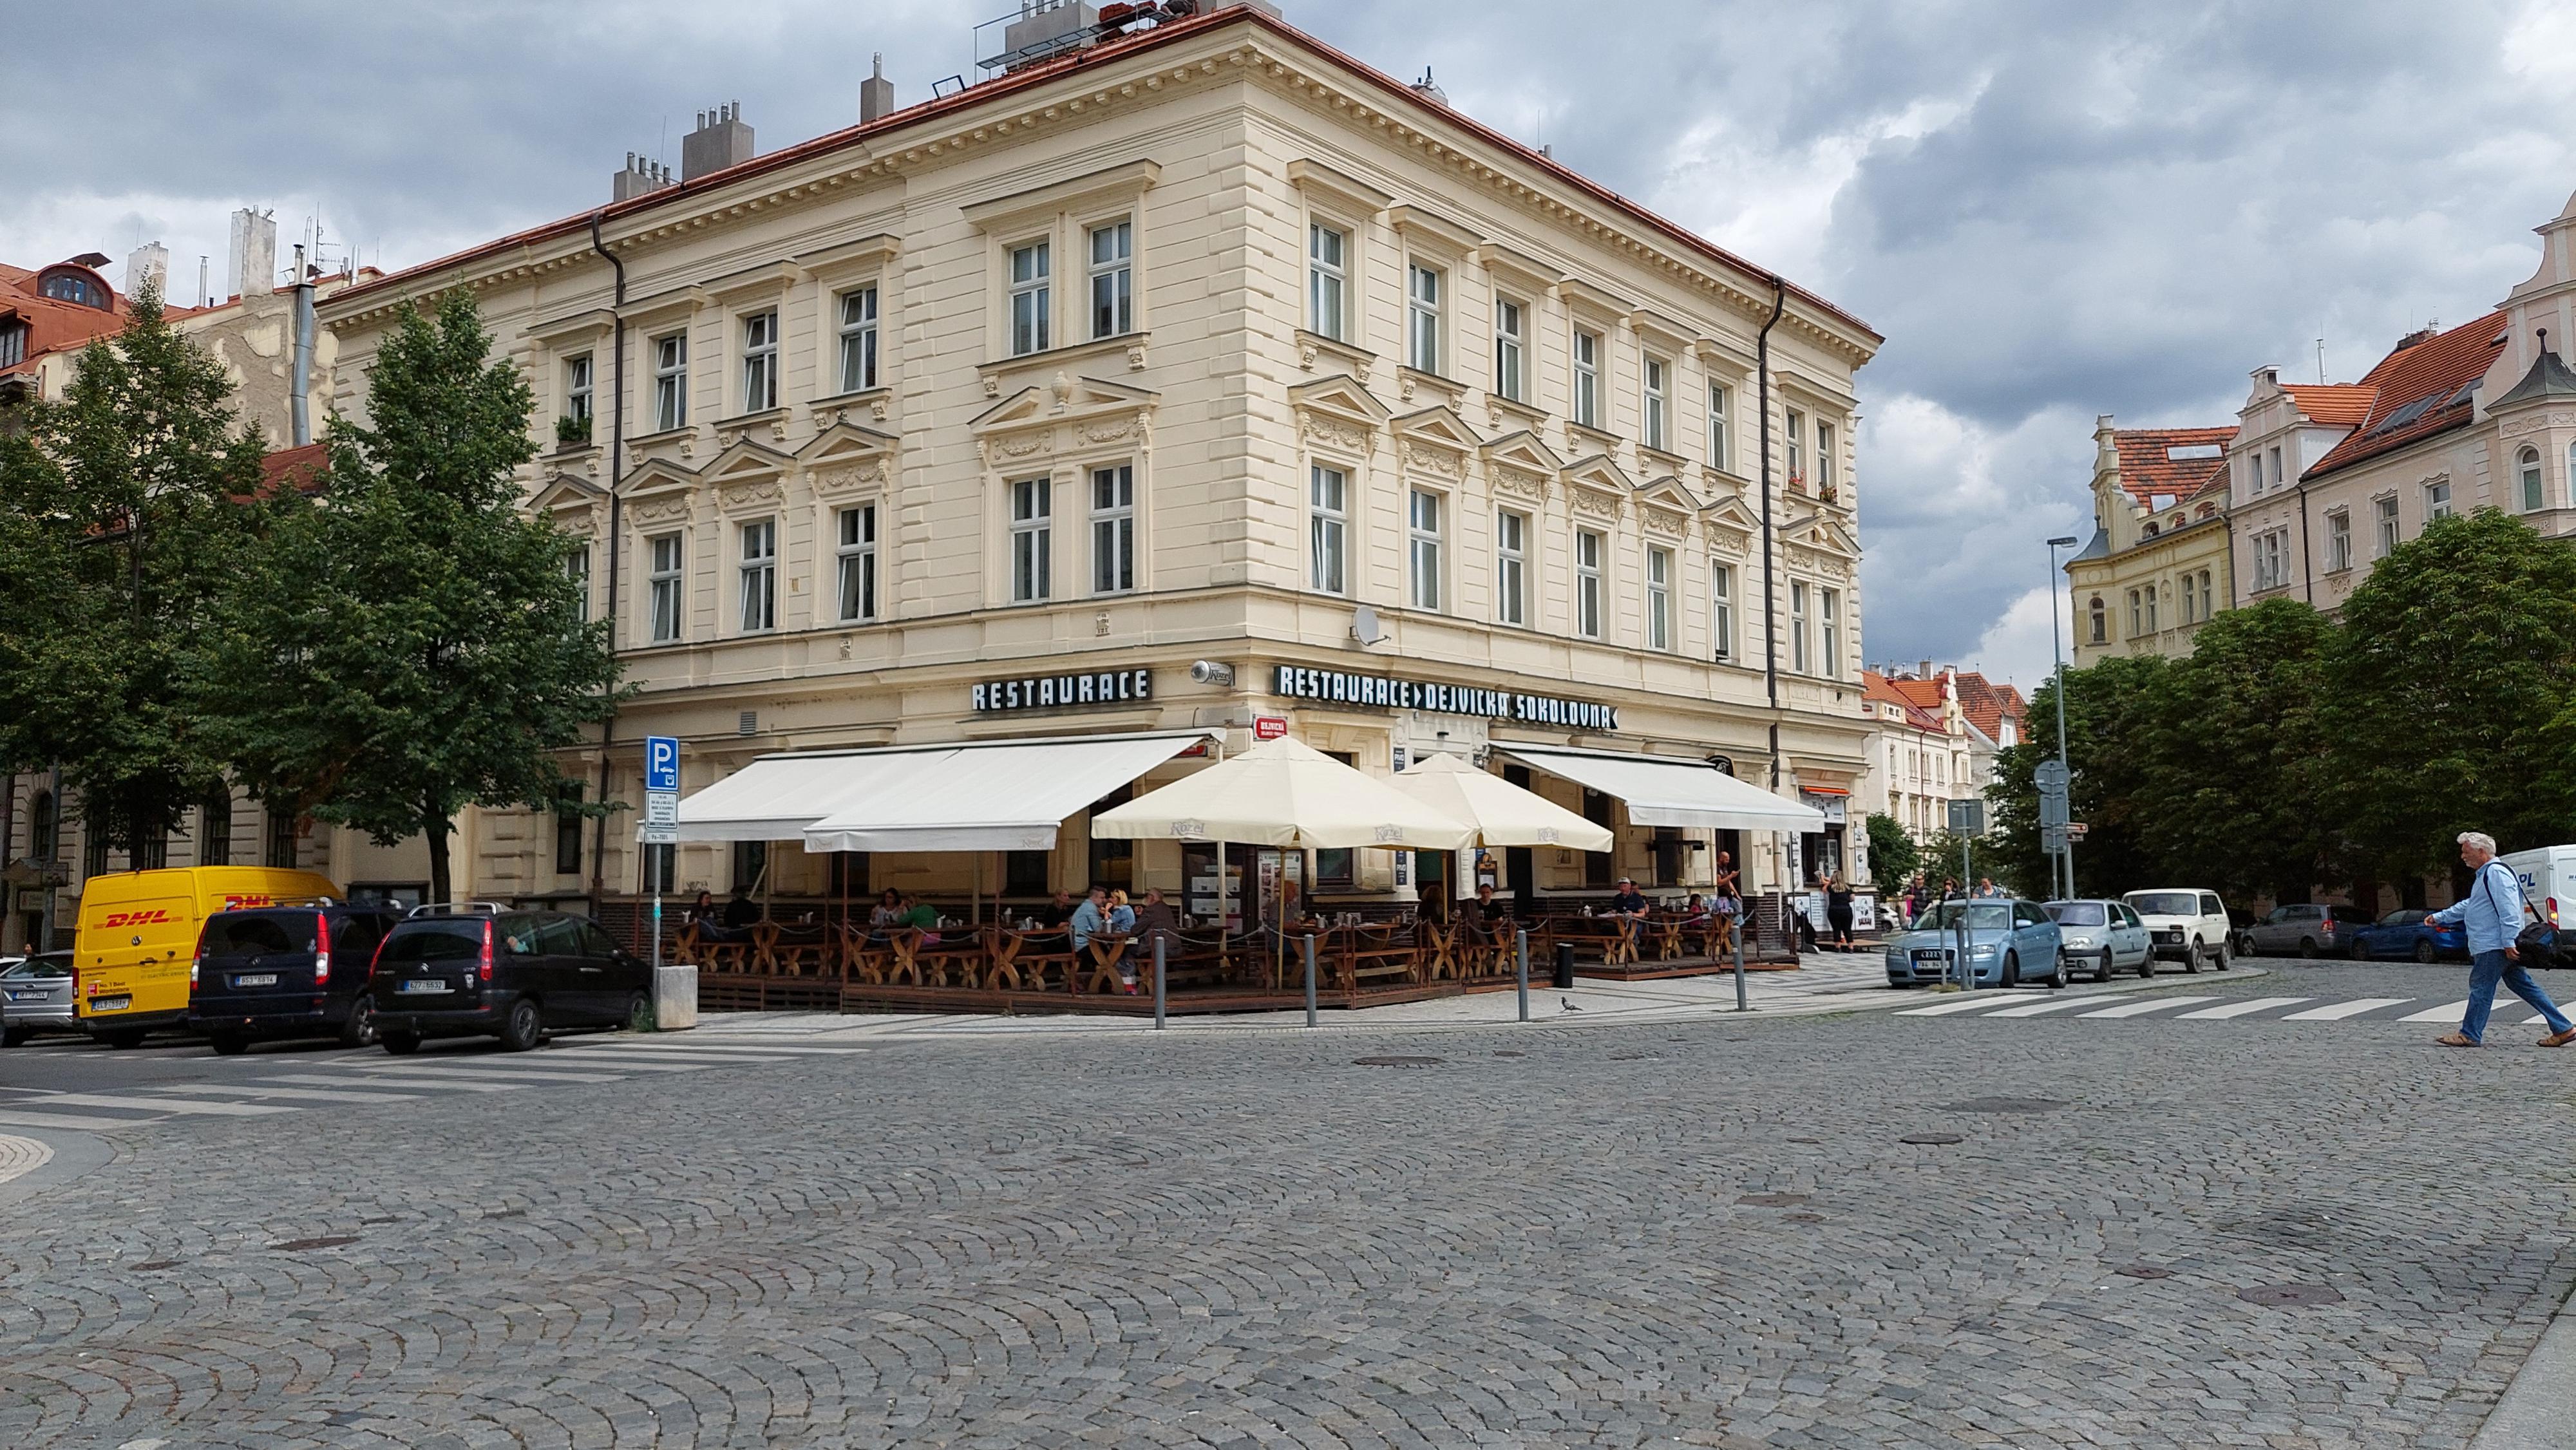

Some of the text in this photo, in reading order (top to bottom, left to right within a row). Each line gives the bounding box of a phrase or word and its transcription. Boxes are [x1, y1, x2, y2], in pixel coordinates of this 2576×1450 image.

[1210, 670, 1231, 681] Kozel
[972, 670, 1147, 710] RESTAURACE
[1280, 666, 1409, 708] RESTAURACE
[1517, 694, 1609, 728] SOKOLOVNA
[654, 743, 672, 773] P
[1170, 821, 1205, 836] Kozel
[1374, 826, 1403, 842] Kozel
[105, 910, 171, 928] DHL
